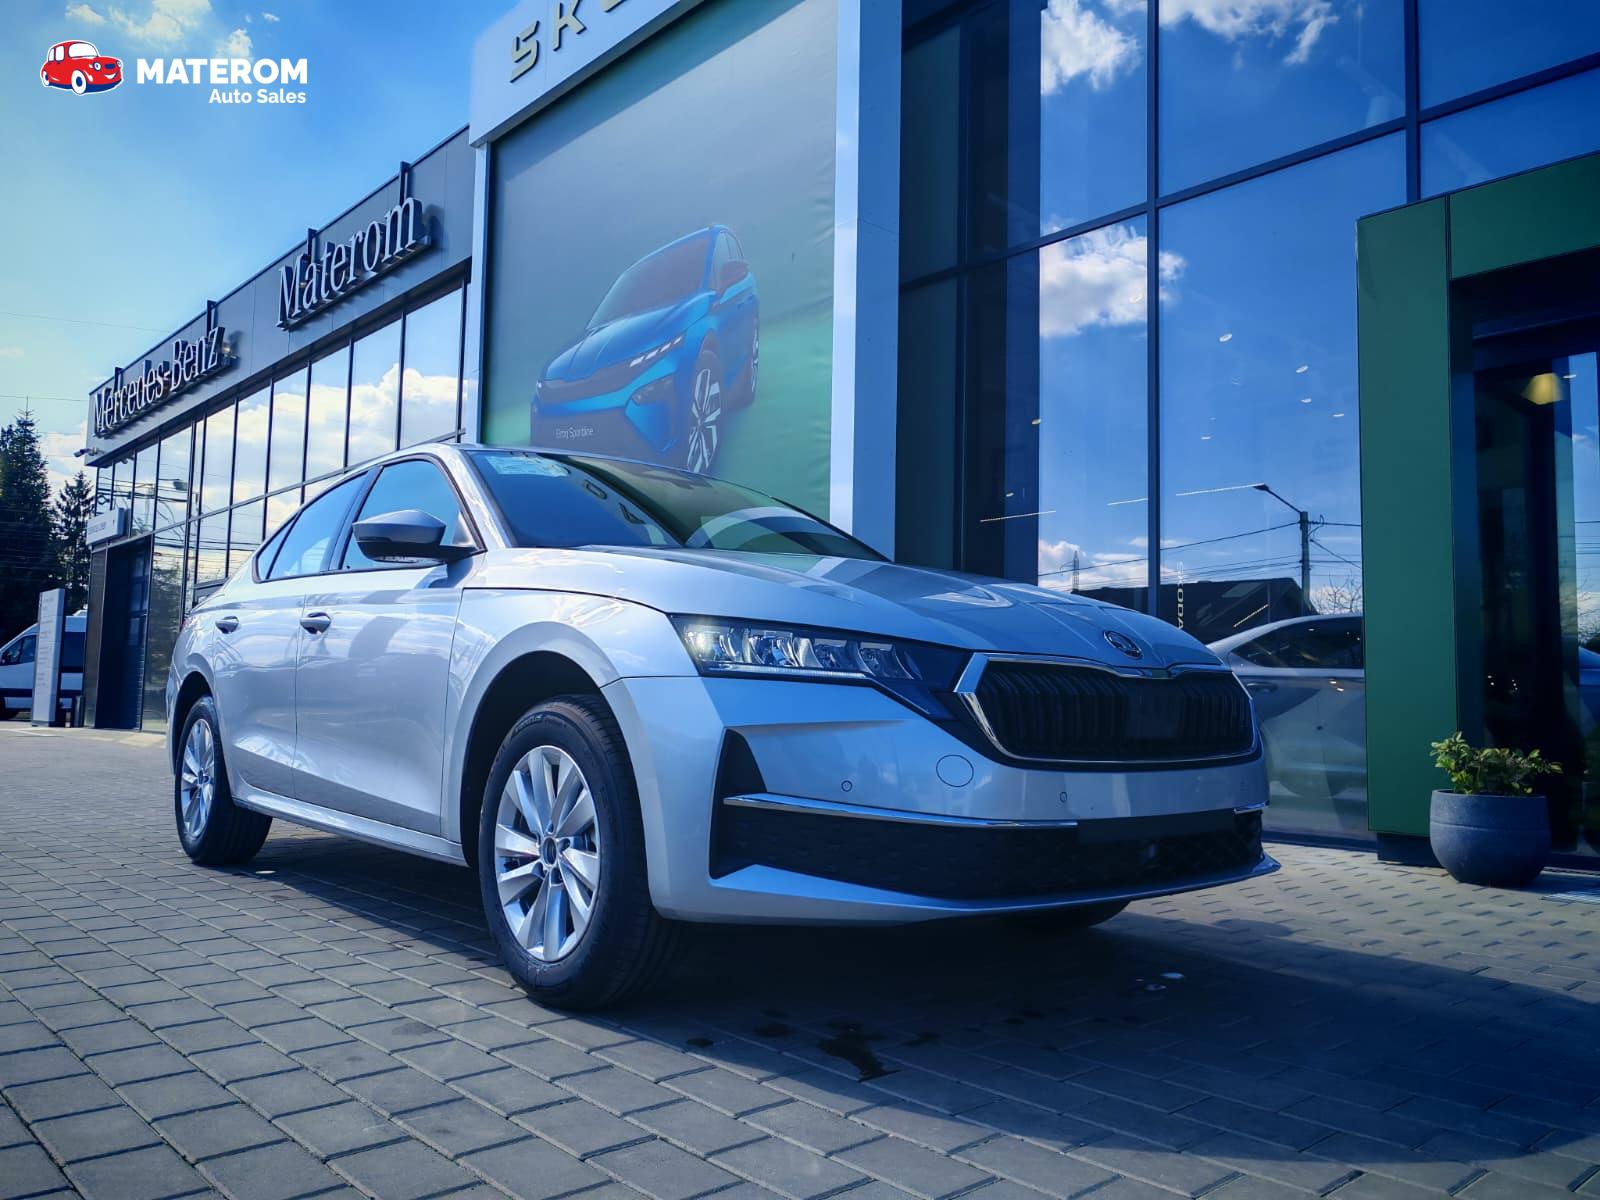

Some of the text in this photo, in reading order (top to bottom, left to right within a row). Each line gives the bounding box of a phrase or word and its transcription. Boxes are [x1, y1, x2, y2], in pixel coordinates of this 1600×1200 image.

[510, 0, 626, 83] SK
[276, 197, 418, 328] Materom
[94, 326, 222, 433] Mercedes-Benz
